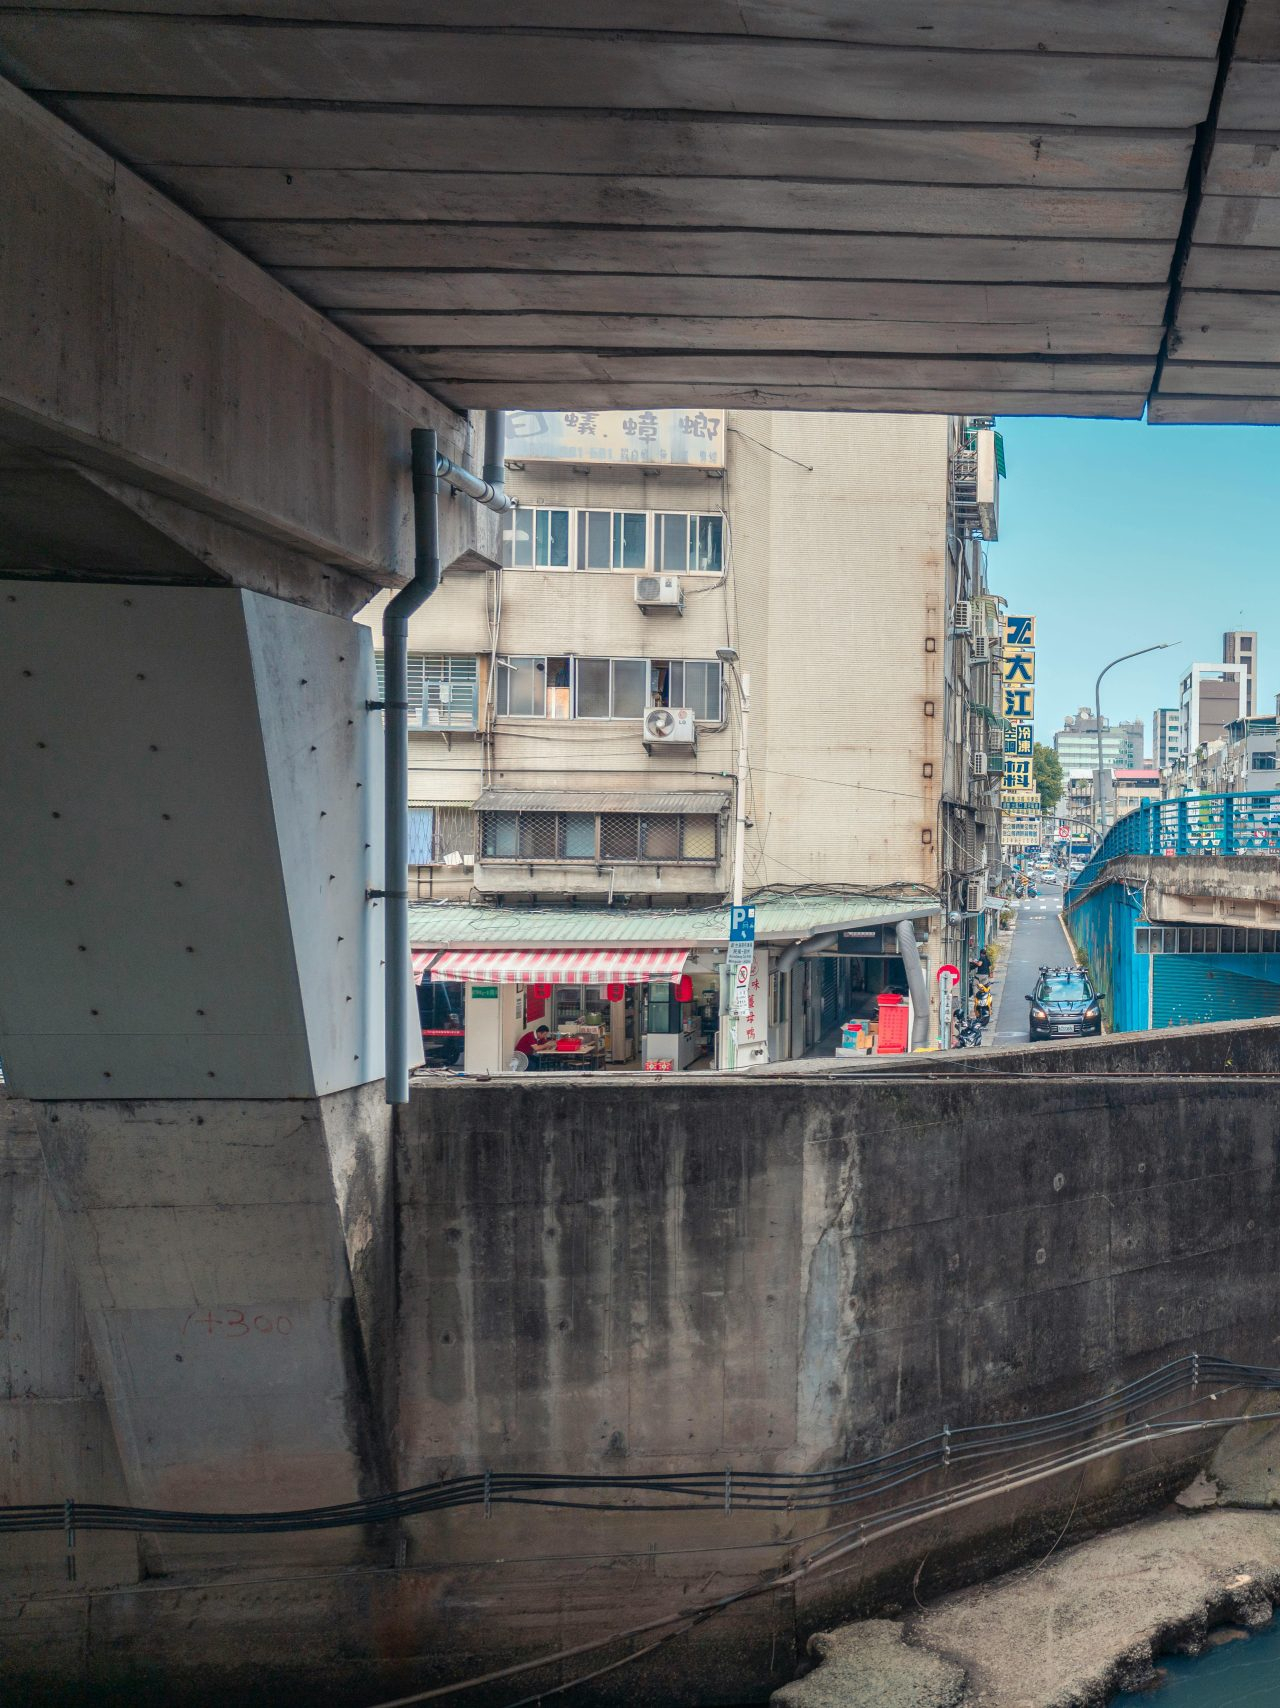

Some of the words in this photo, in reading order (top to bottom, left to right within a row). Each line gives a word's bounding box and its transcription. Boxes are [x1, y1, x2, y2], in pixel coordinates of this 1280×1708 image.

[1004, 653, 1032, 717] 大江
[1018, 726, 1032, 754] 冷凍
[1003, 760, 1030, 788] 材料
[732, 908, 746, 930] P
